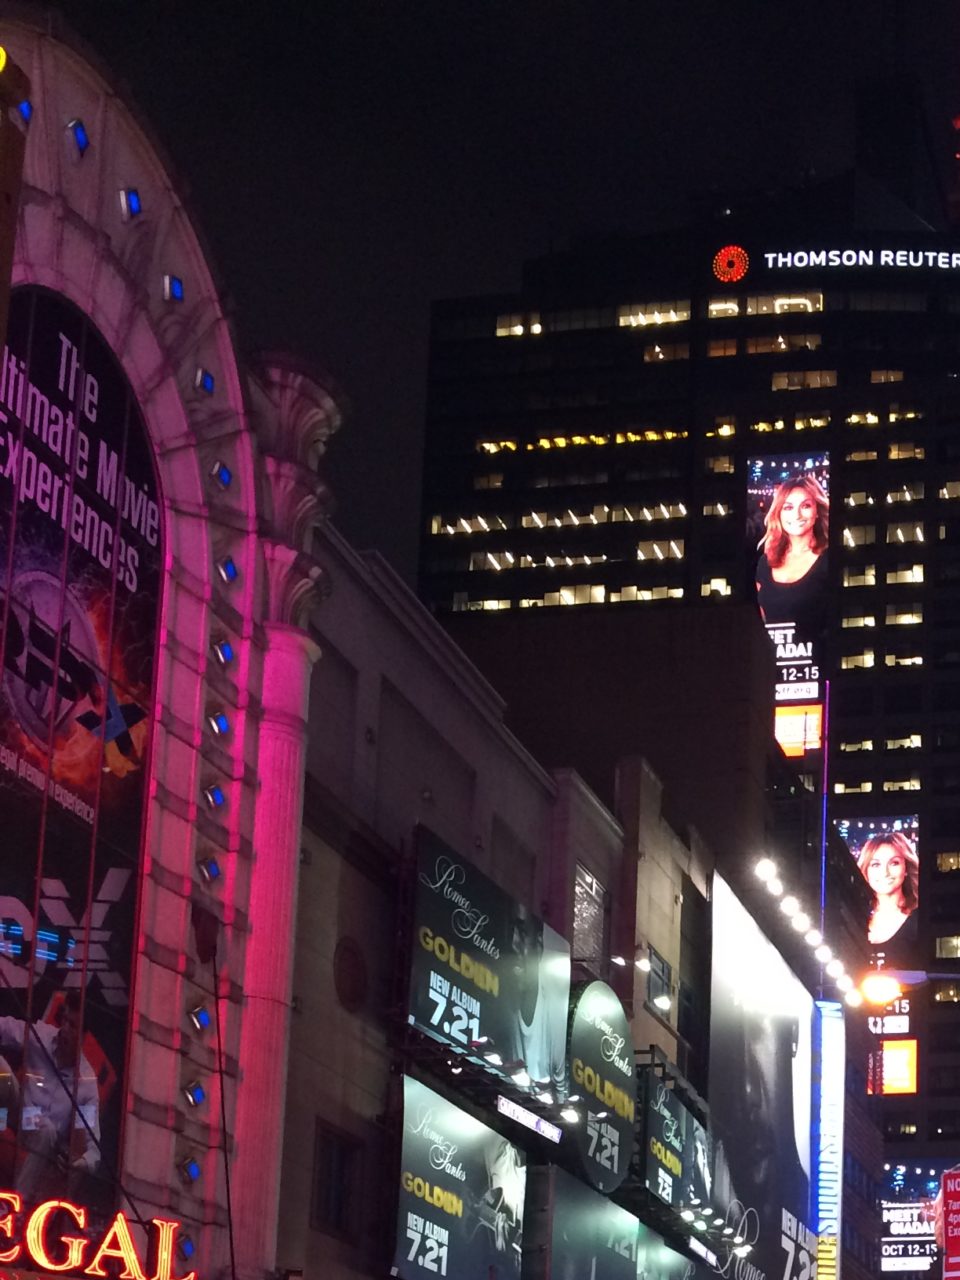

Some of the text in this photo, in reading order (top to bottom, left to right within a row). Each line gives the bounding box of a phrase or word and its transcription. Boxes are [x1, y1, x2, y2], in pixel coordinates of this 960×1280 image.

[764, 250, 874, 268] THOMSON
[58, 332, 99, 423] The
[782, 666, 819, 681] 12-15
[451, 908, 500, 960] Santos
[418, 926, 499, 998] GOLDEN
[428, 988, 481, 1046] 7.21
[429, 970, 481, 1019] NEW ALBUM
[572, 1057, 635, 1124] GOLDEN
[429, 1140, 467, 1182] Santos
[587, 1126, 619, 1175] 7.21
[650, 1136, 682, 1178] GOLDEN
[401, 1171, 463, 1218] GOLDEN
[406, 1211, 449, 1246] NEW ALBUM
[406, 1228, 449, 1277] 7.21
[882, 1245, 905, 1256] OCT
